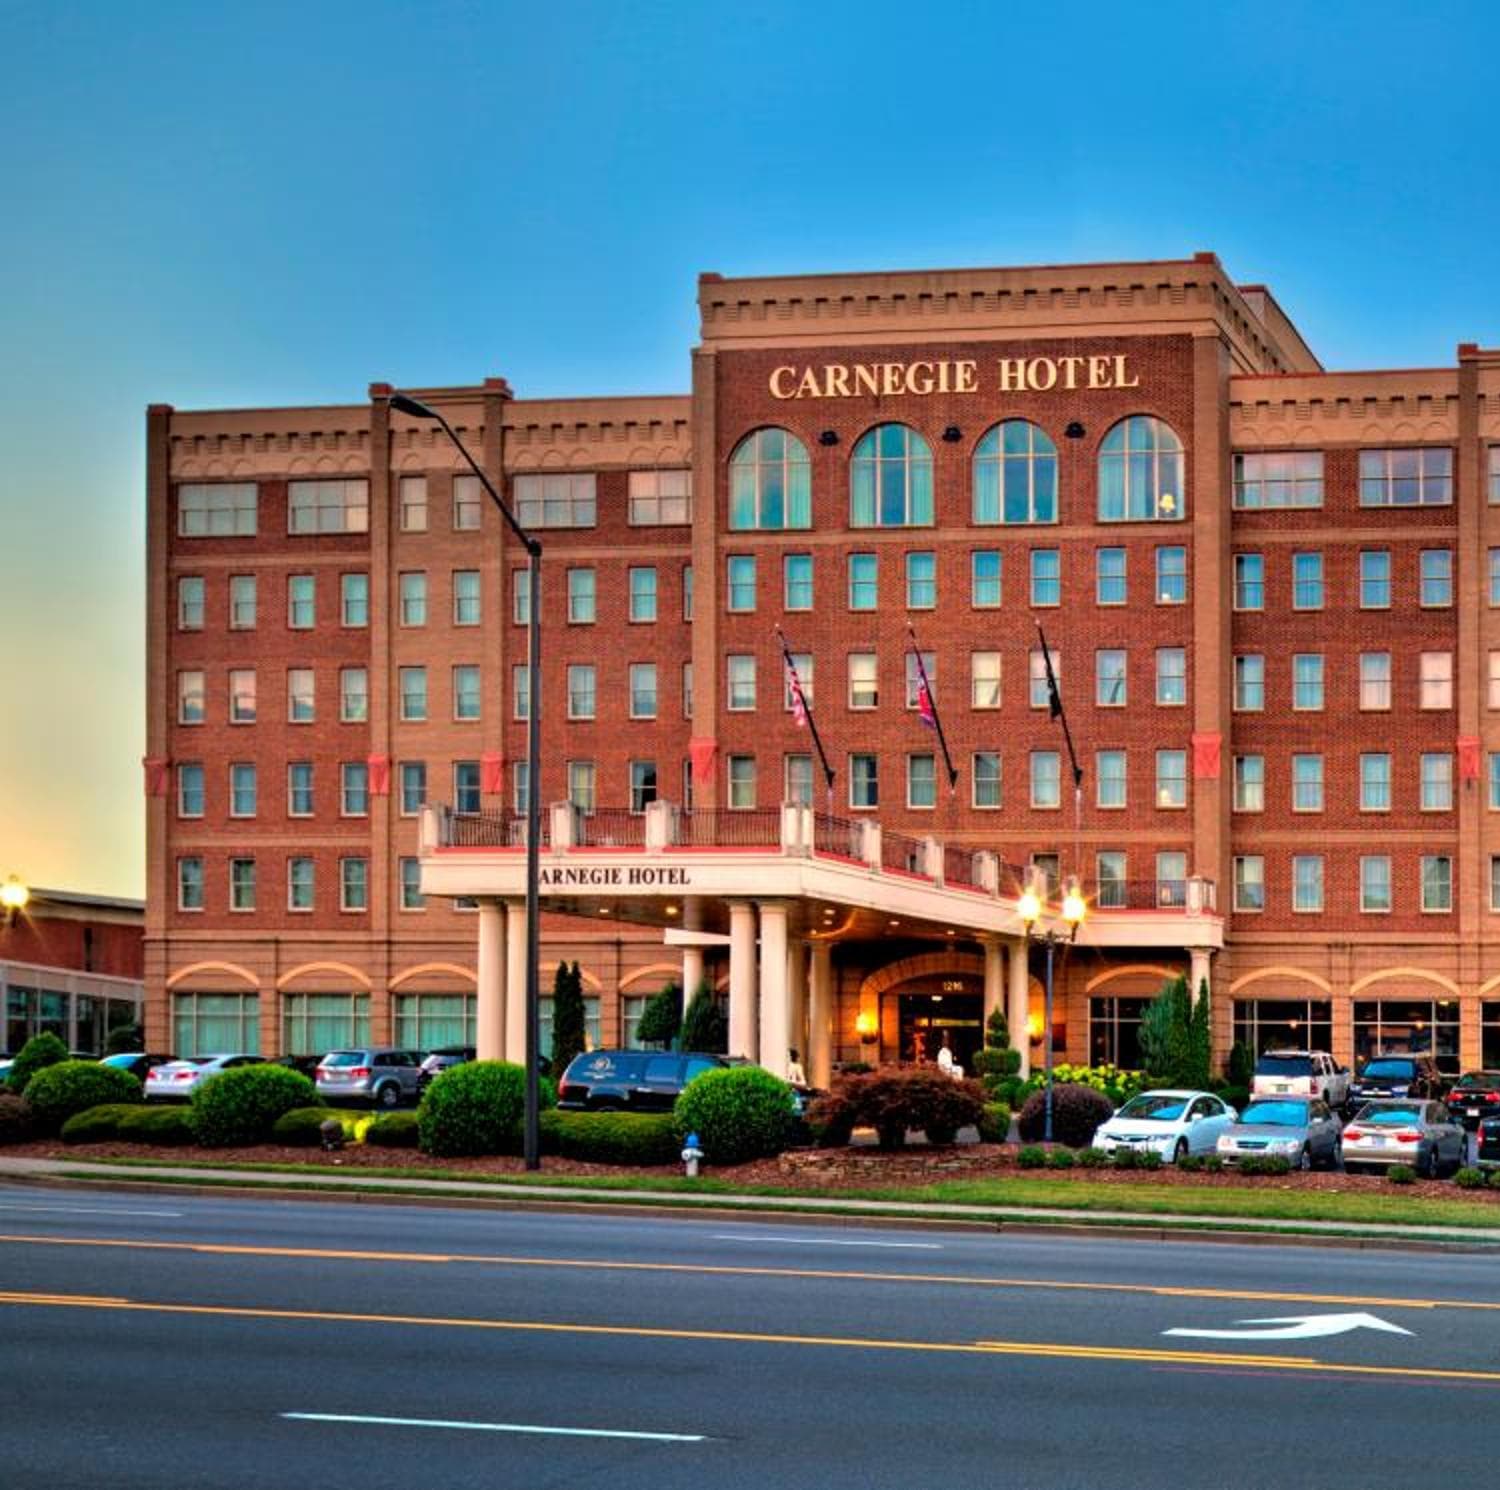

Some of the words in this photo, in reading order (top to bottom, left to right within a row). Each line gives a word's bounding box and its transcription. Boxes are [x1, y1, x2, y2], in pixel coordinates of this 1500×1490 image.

[768, 360, 978, 399] CARNEGIE
[999, 355, 1140, 391] HOTEL
[539, 868, 622, 885] ARNEGIE
[629, 868, 691, 885] HOTEL
